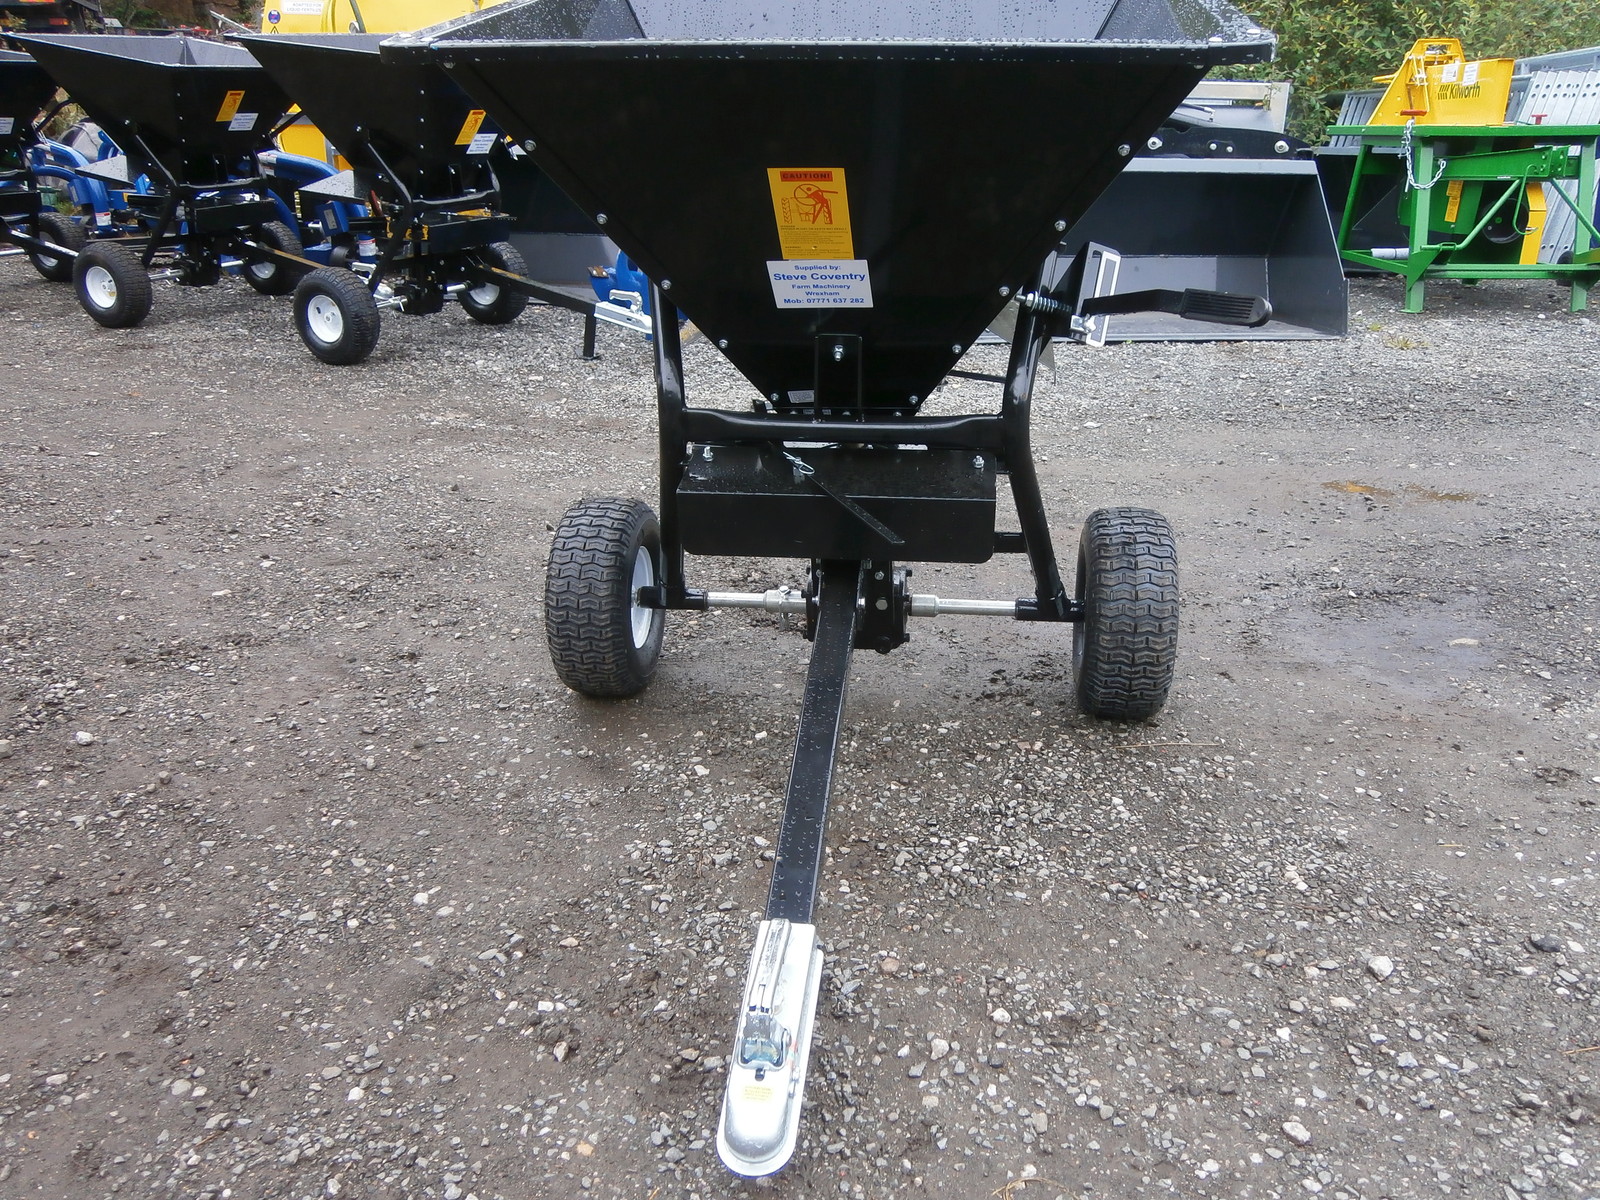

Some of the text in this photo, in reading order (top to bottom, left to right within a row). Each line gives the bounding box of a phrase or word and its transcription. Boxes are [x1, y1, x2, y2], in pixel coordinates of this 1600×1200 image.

[1449, 81, 1481, 99] Kilworth
[773, 273, 866, 281] Steve Coventry
